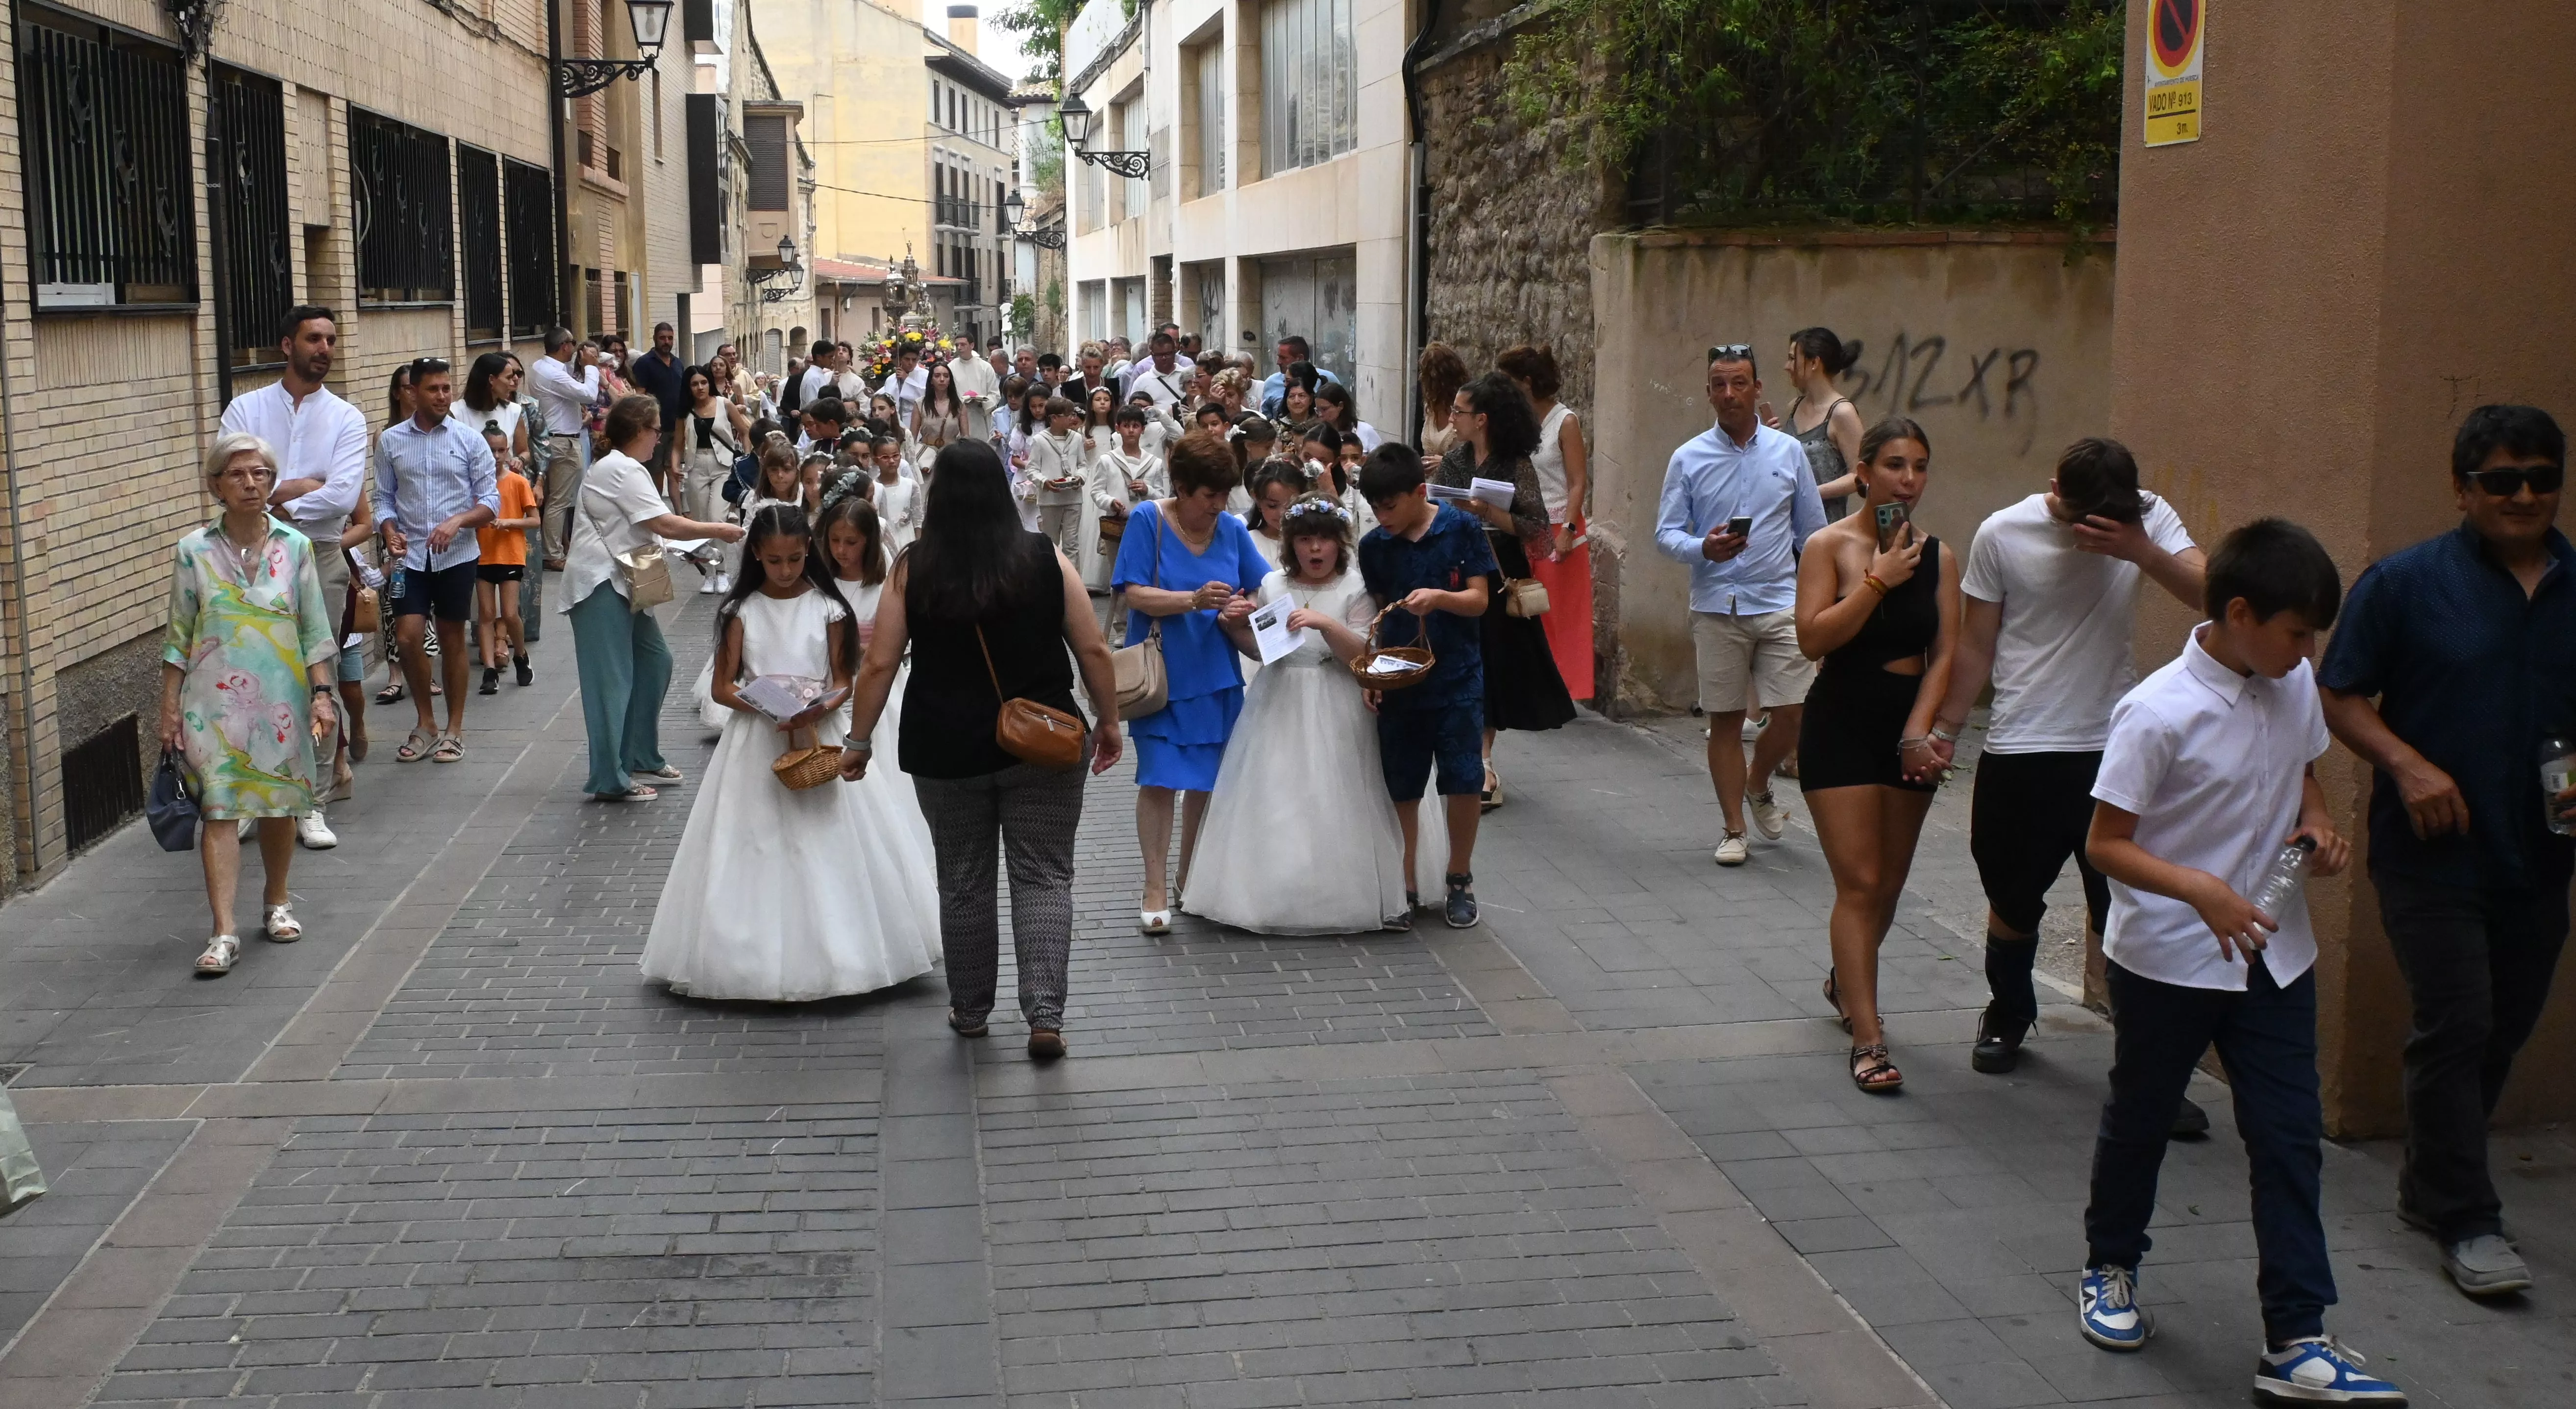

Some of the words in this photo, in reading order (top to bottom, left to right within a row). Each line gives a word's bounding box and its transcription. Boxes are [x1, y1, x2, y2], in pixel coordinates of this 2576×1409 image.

[2149, 93, 2167, 113] VADO
[2168, 91, 2177, 109] Nº
[2178, 92, 2192, 107] 913
